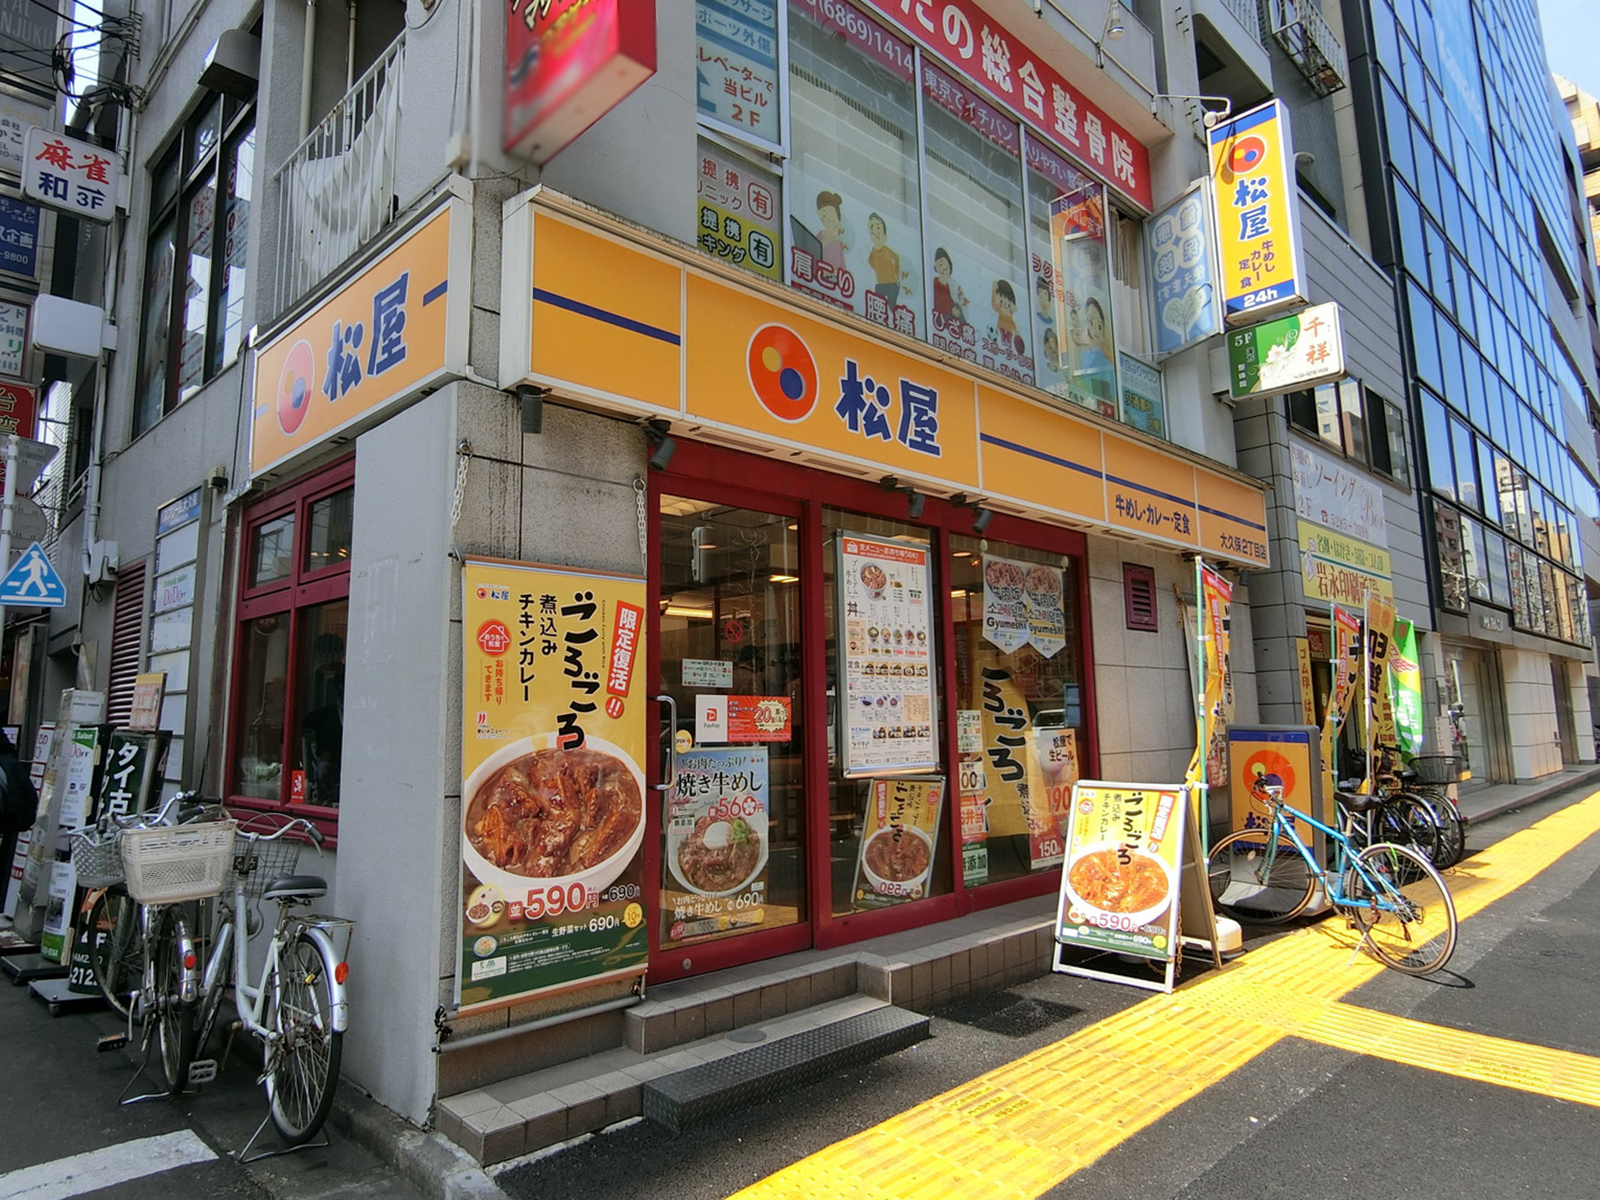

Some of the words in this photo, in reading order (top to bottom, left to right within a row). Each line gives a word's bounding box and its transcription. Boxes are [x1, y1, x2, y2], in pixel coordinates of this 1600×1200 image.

[696, 47, 774, 93] レベーターで
[724, 77, 768, 107] 当ビル
[923, 66, 1013, 142] 東京でイチバン
[35, 139, 111, 186] 麻雀
[38, 171, 69, 202] 和
[76, 191, 104, 210] 3F
[1233, 178, 1270, 241] 松屋
[792, 246, 855, 299] 肩こり
[1250, 250, 1262, 281] カレー
[1262, 240, 1275, 273] 牛めし
[1243, 288, 1278, 308] 24h
[321, 269, 410, 402] 松屋
[1234, 332, 1253, 346] 5F
[836, 358, 942, 458] 松屋
[1115, 494, 1191, 536] 牛めし・カレー・定食
[518, 593, 535, 701] チキンカレー
[539, 593, 558, 656] 煮込み
[986, 617, 1028, 631] Gyumeshi
[557, 591, 600, 750] ごろごろ
[608, 607, 638, 691] 限定復活
[703, 722, 720, 730] PayPay
[676, 771, 763, 798] 焼き牛めし
[1117, 791, 1144, 866] ごろごろ
